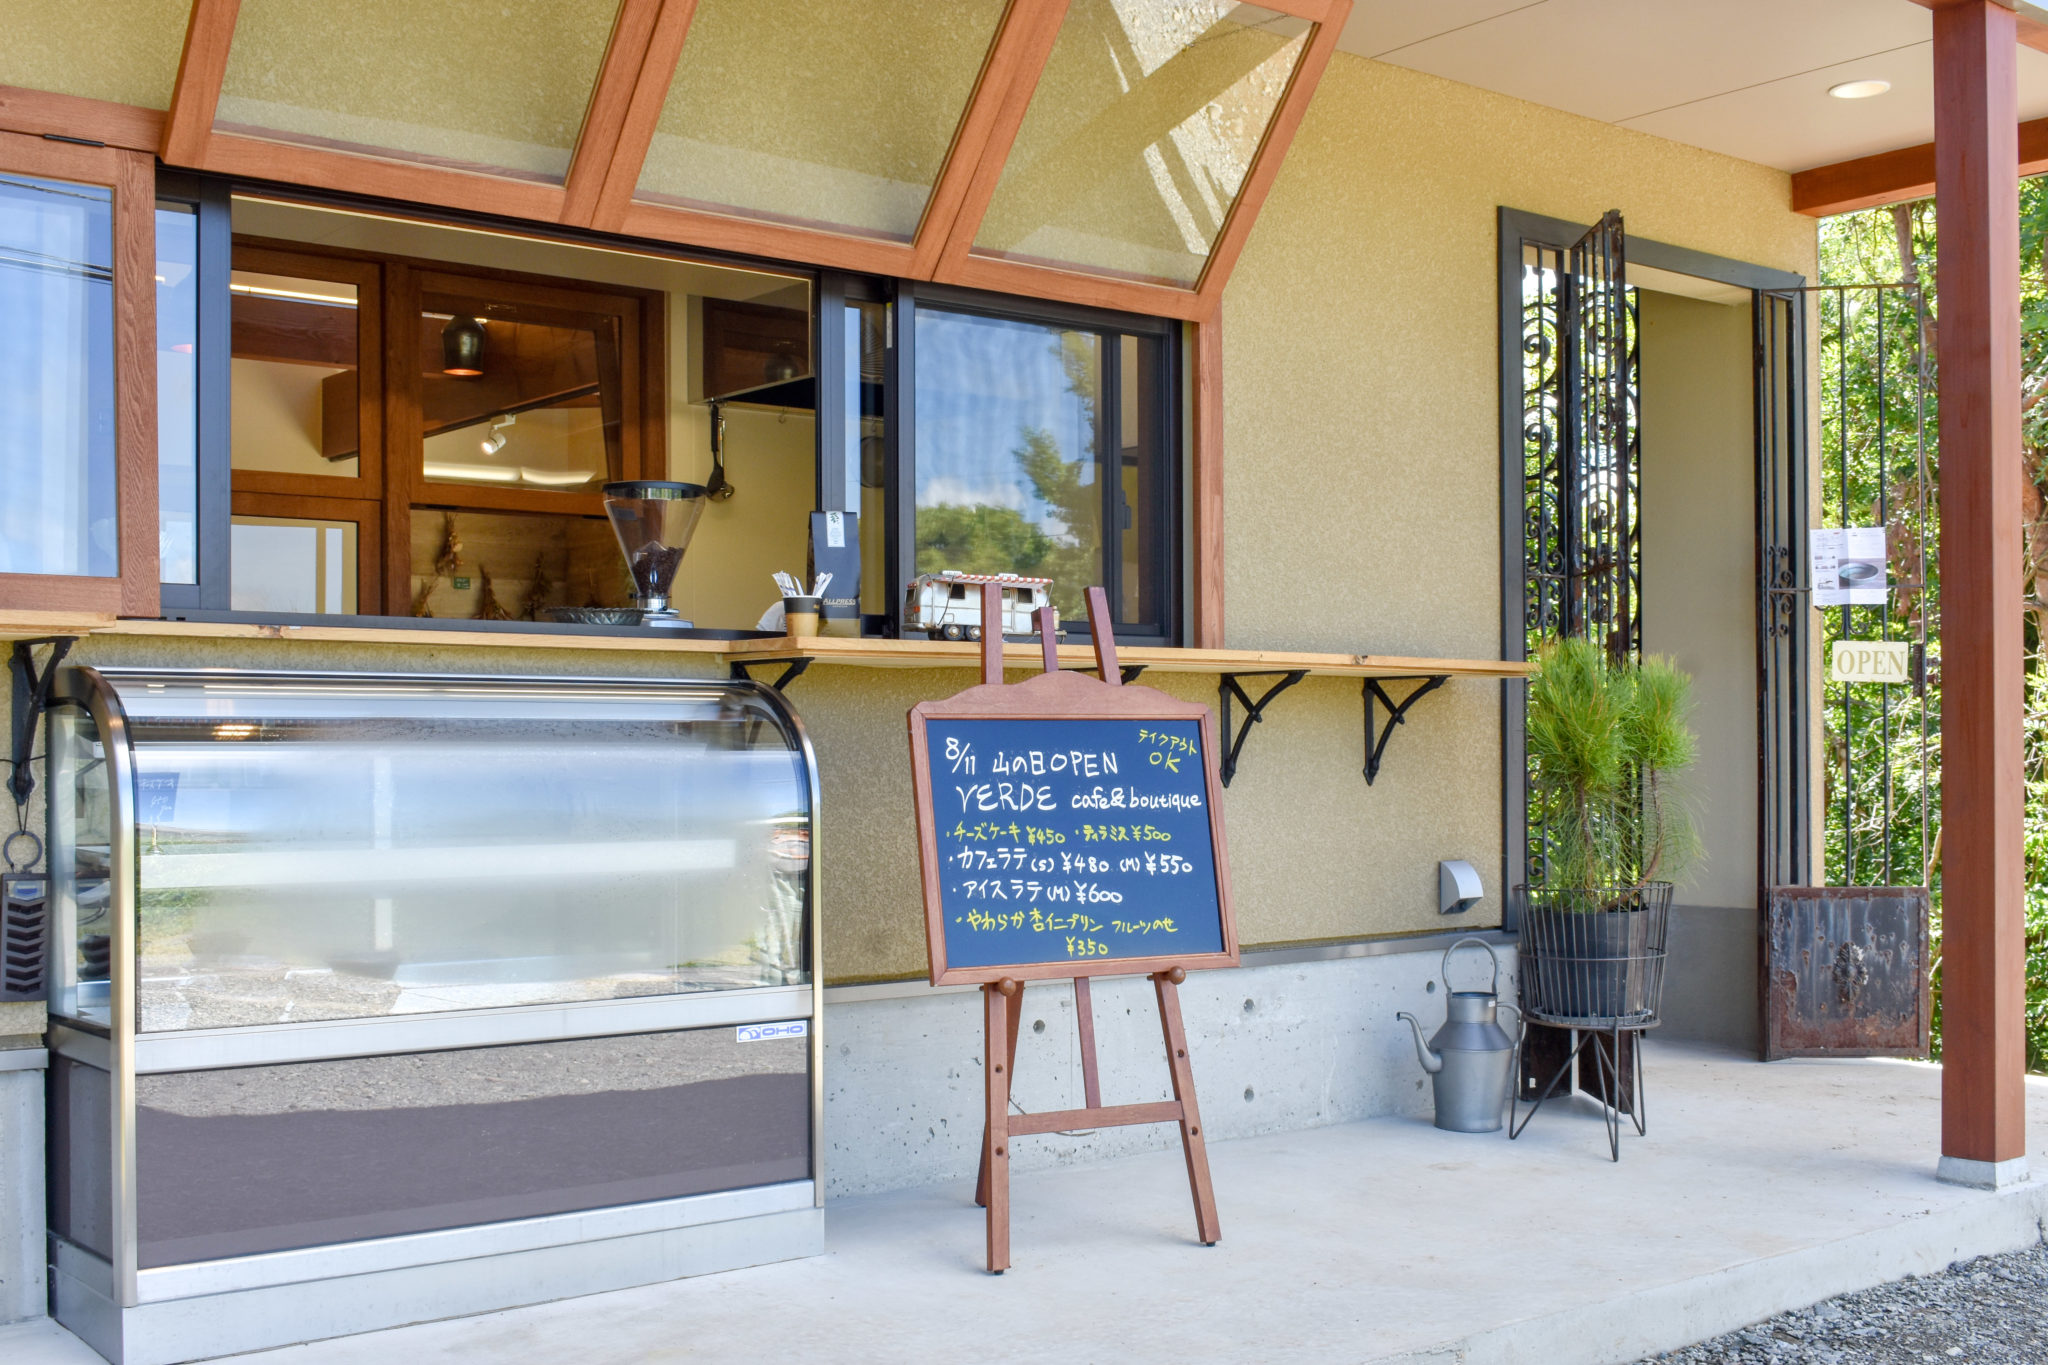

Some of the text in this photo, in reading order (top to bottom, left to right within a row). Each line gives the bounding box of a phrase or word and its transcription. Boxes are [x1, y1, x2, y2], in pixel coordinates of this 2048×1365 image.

[1837, 650, 1905, 675] OPEN
[1138, 728, 1198, 756] テイクアウト
[1149, 751, 1181, 774] OK
[1025, 825, 1066, 846] ¥450
[1130, 824, 1172, 842] ¥500
[1060, 851, 1110, 875] ¥480
[1144, 850, 1193, 877] ¥550
[1073, 879, 1124, 905] ¥600
[1065, 935, 1109, 957] ¥350
